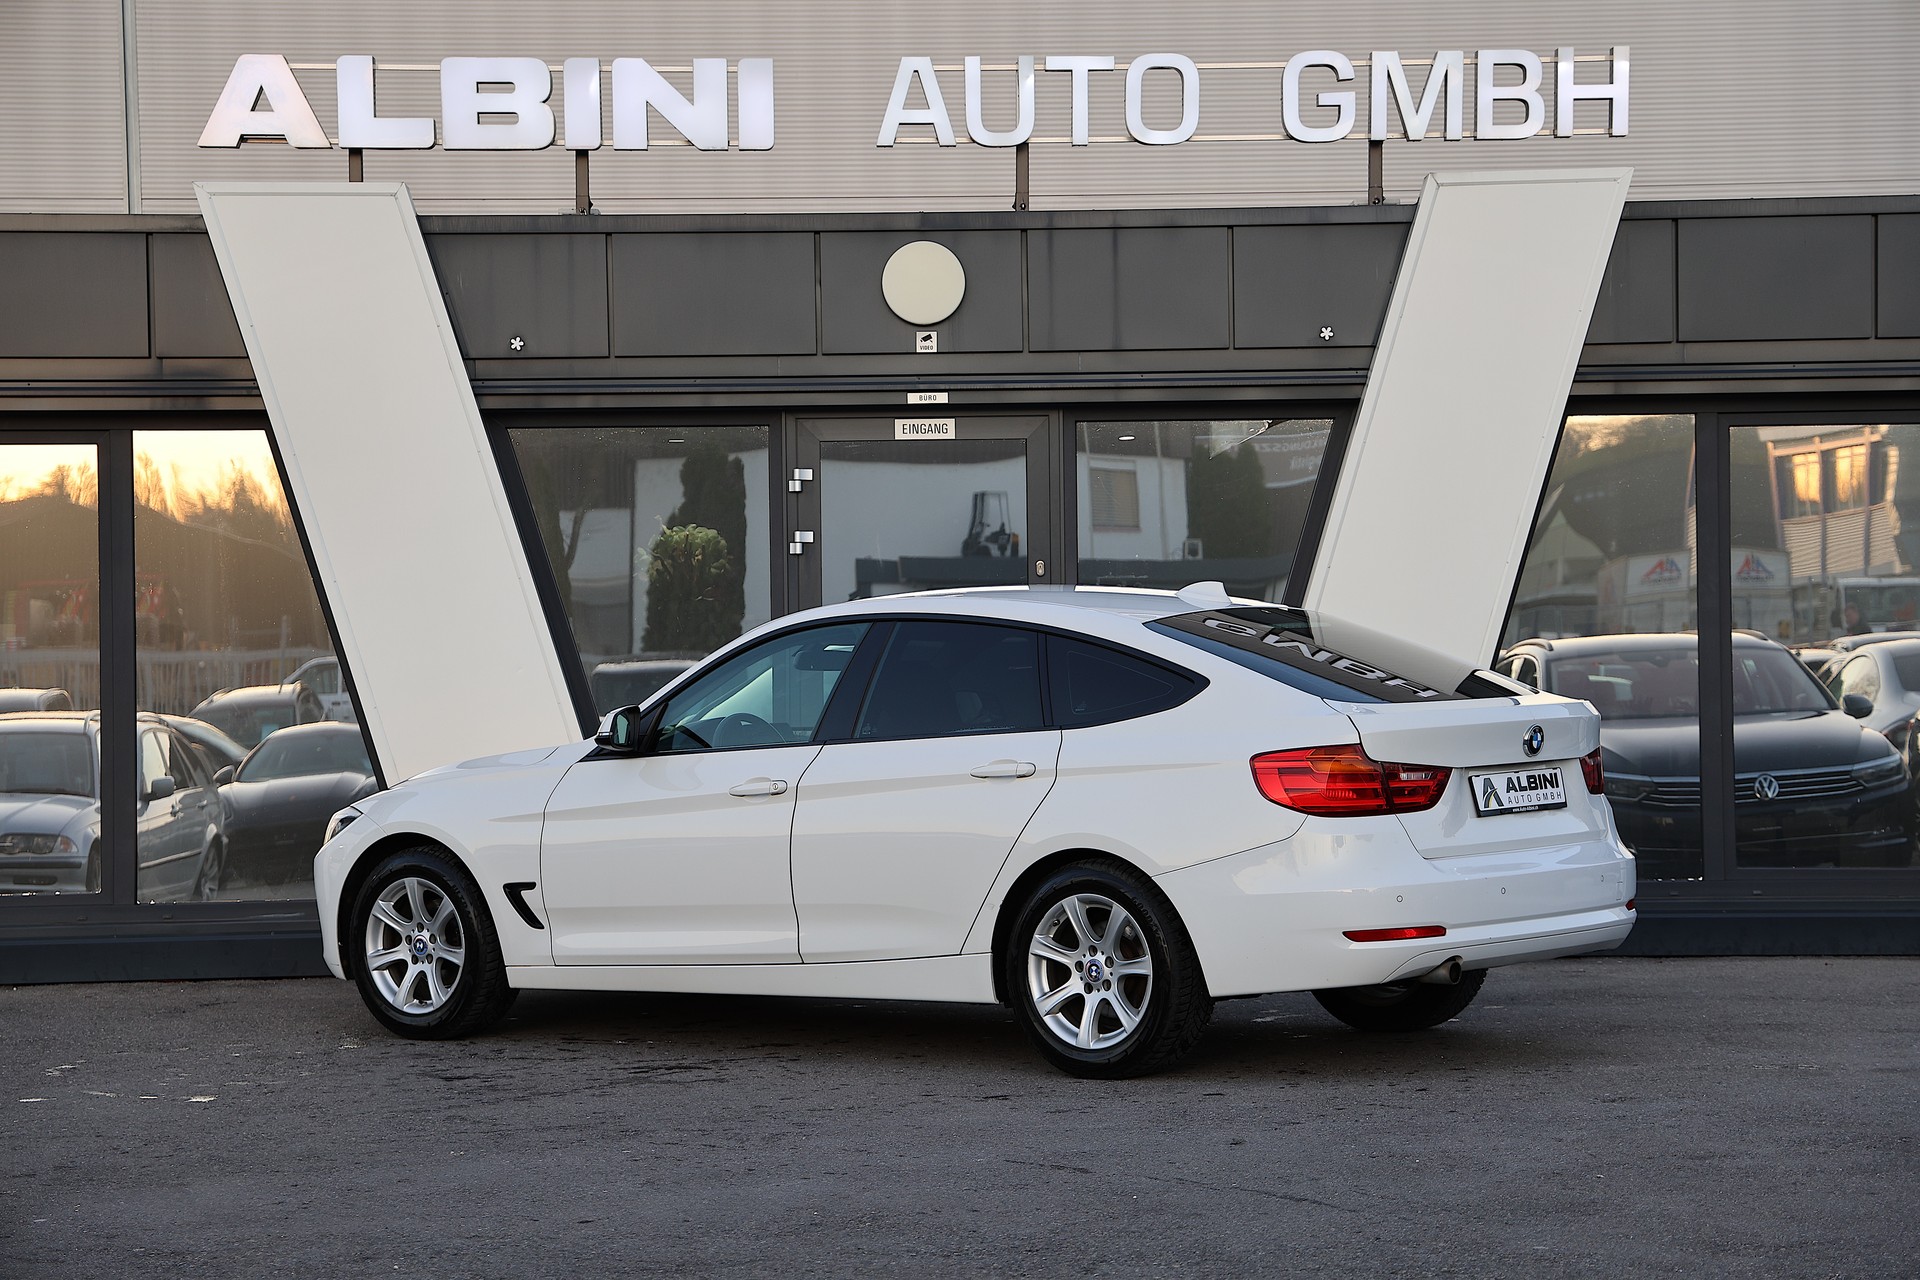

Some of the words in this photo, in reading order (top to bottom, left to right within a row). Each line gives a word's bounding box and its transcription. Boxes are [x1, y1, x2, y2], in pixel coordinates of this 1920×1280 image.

[197, 53, 775, 151] ALBINI
[876, 52, 1201, 148] AUTO
[1281, 46, 1631, 142] GMBH
[918, 394, 937, 402] BÜRO
[902, 423, 949, 435] EINGANG
[1506, 772, 1560, 793] ALBINI
[1508, 793, 1532, 805] AUTO
[1535, 791, 1562, 802] GMBH
